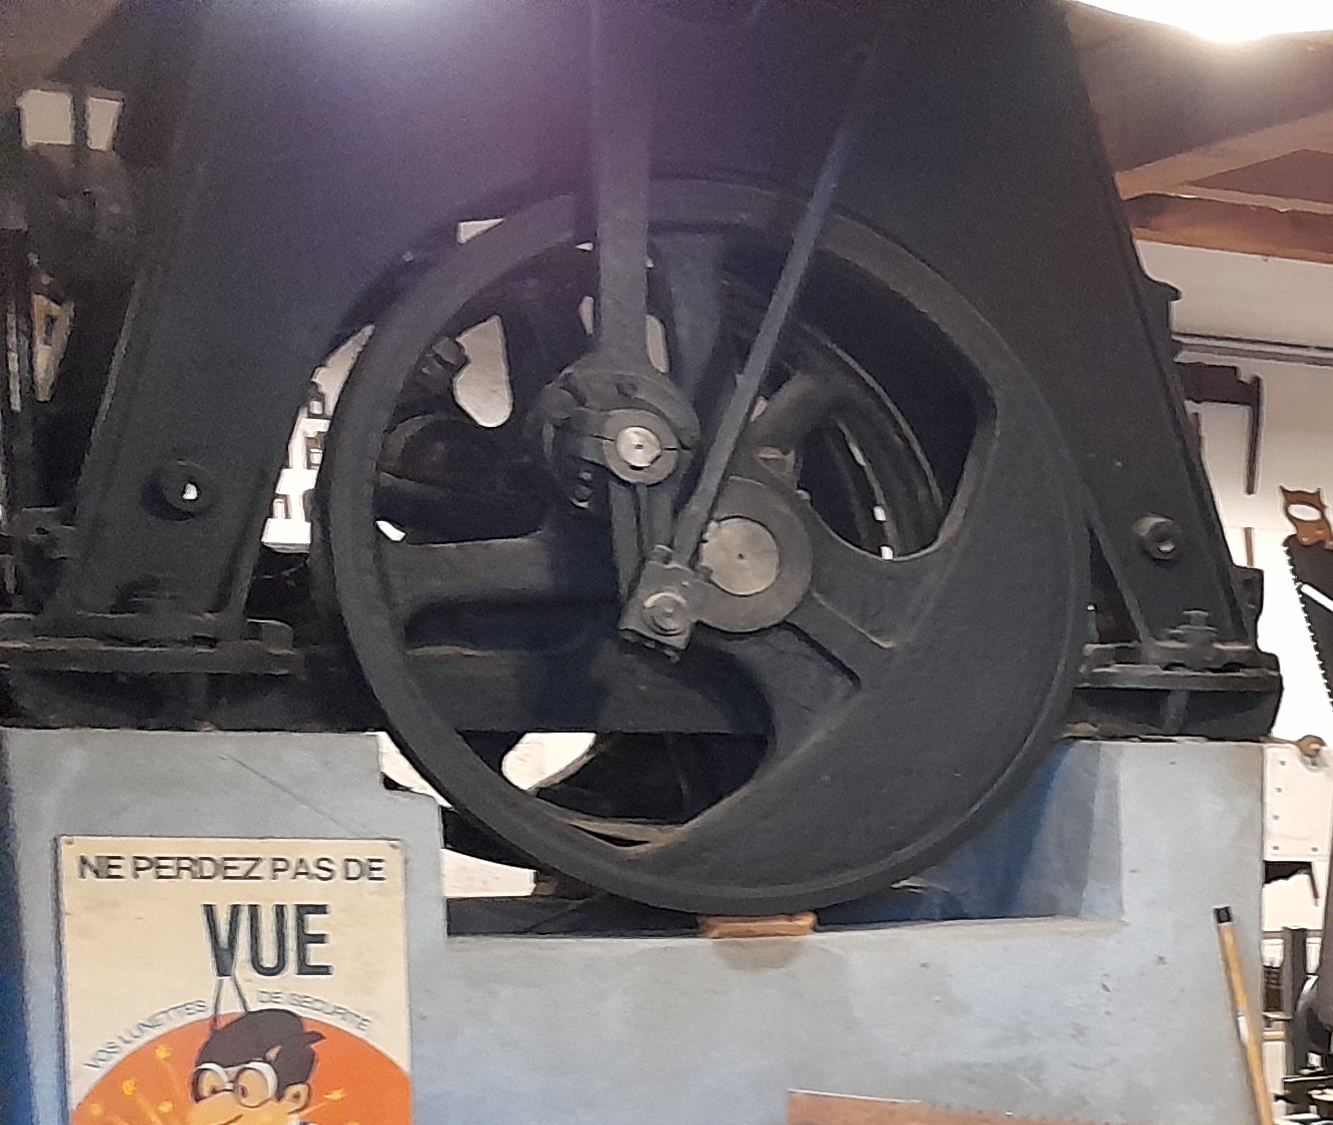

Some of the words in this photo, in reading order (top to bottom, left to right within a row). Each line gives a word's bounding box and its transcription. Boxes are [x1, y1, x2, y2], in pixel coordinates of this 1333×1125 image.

[78, 855, 124, 880] NE
[131, 856, 263, 881] PERDEZ
[271, 857, 335, 882] PAS
[343, 858, 387, 881] DE
[202, 903, 334, 977] VUE
[117, 999, 207, 1044] LUNETTES
[258, 989, 282, 1004] DE
